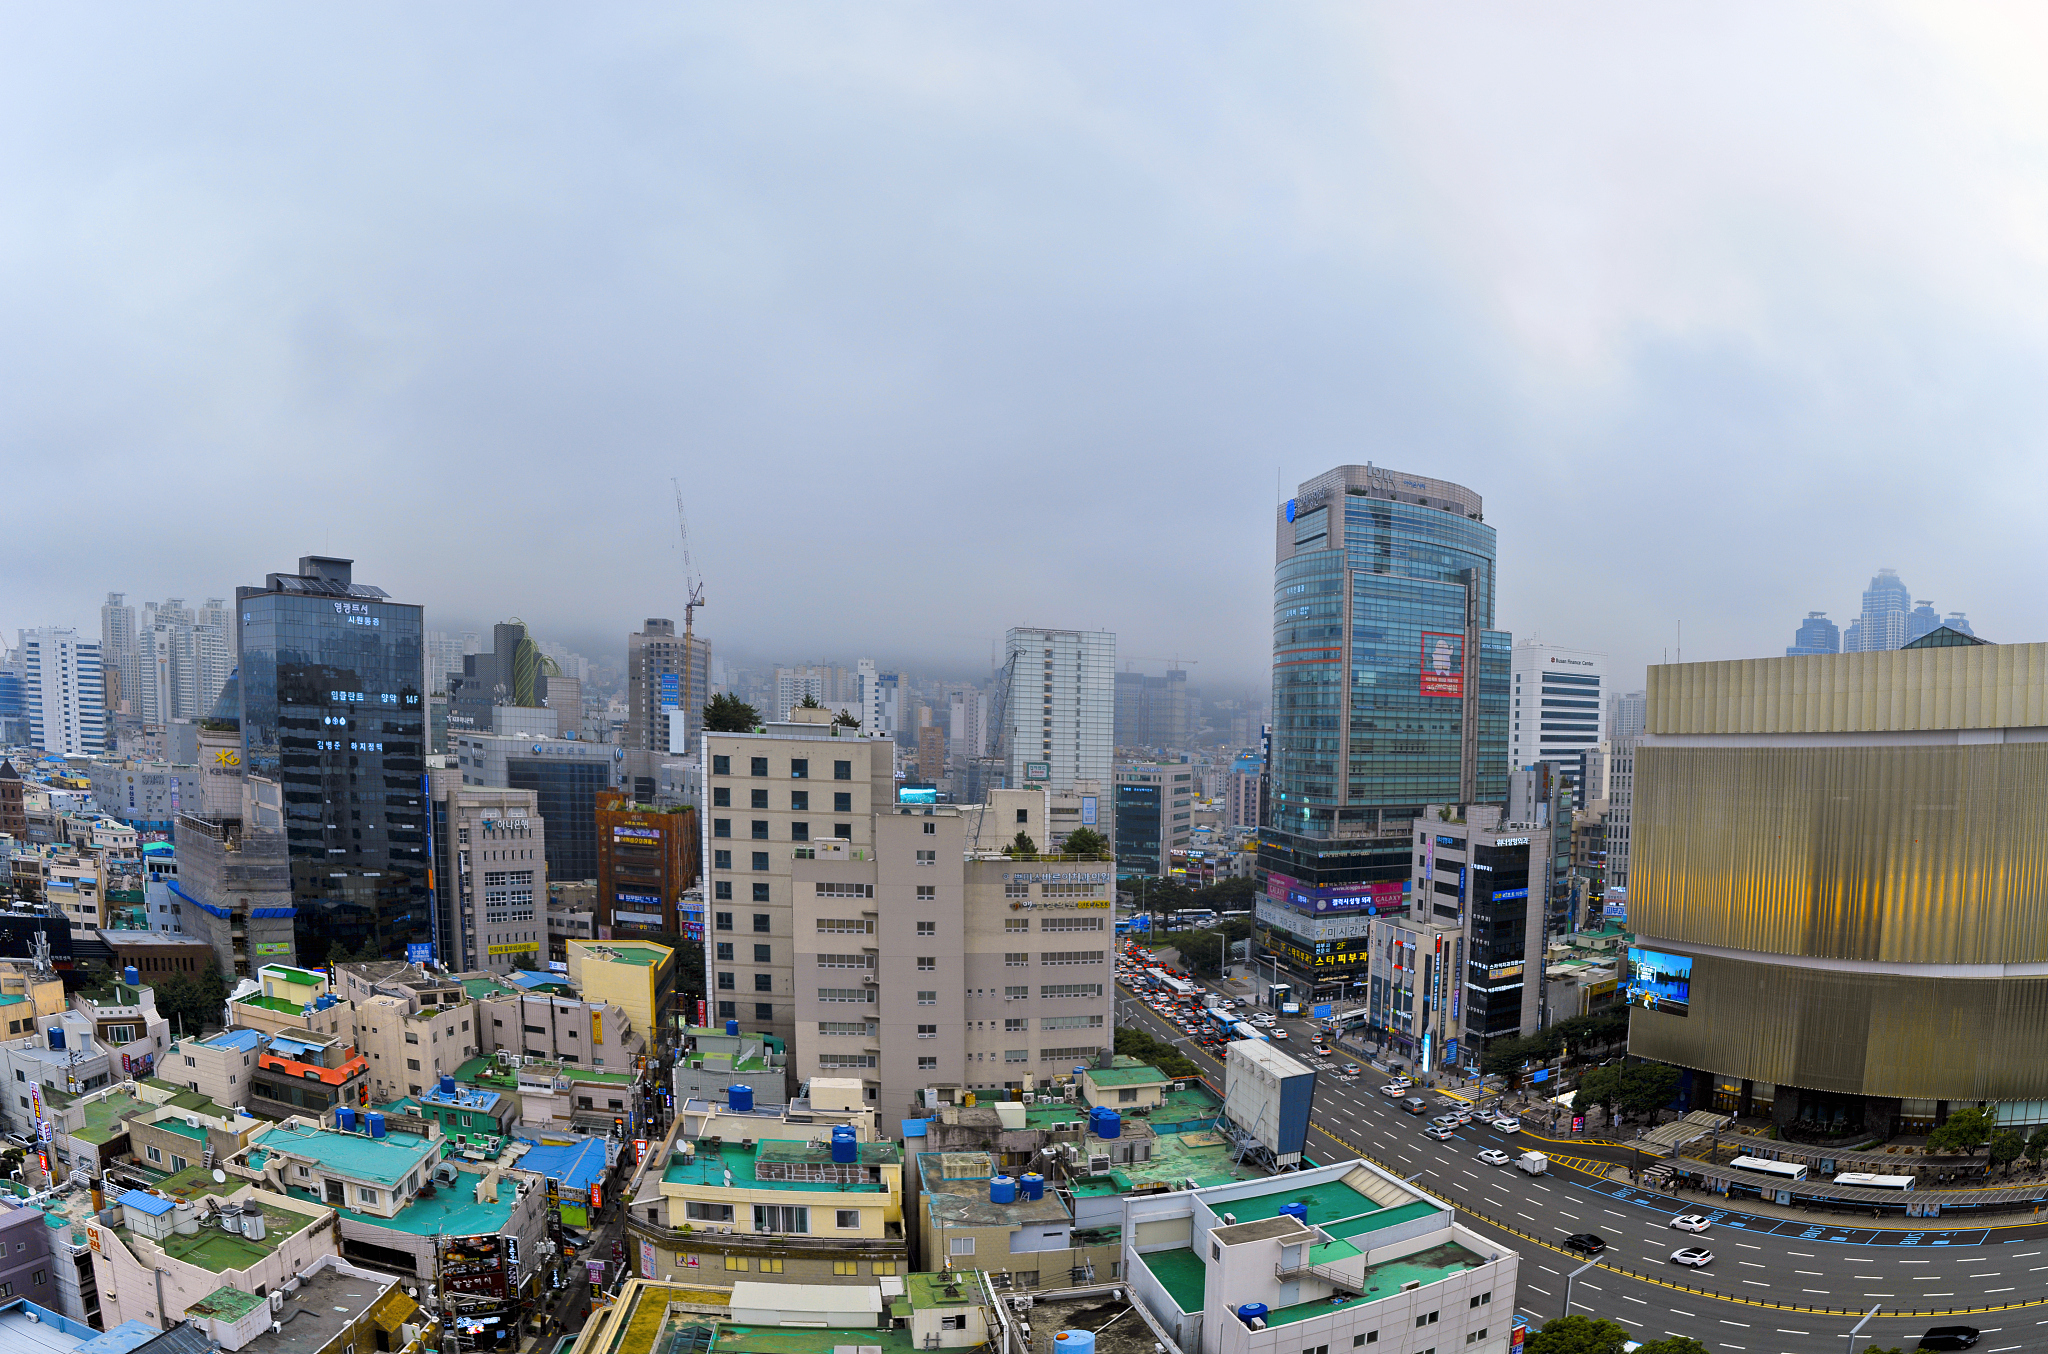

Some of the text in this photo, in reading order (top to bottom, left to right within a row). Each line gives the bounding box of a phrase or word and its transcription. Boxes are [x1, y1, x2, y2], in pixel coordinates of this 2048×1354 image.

[1372, 477, 1400, 492] CITY
[405, 695, 419, 704] 14F
[497, 819, 529, 830] 하나은행
[1375, 895, 1402, 903] GALAXY
[1336, 942, 1347, 950] 2F
[1314, 951, 1368, 966] 스타피부과
[1799, 1226, 1826, 1239] BUS
[1899, 1232, 1925, 1245] BUS
[86, 1227, 102, 1253] 여관
